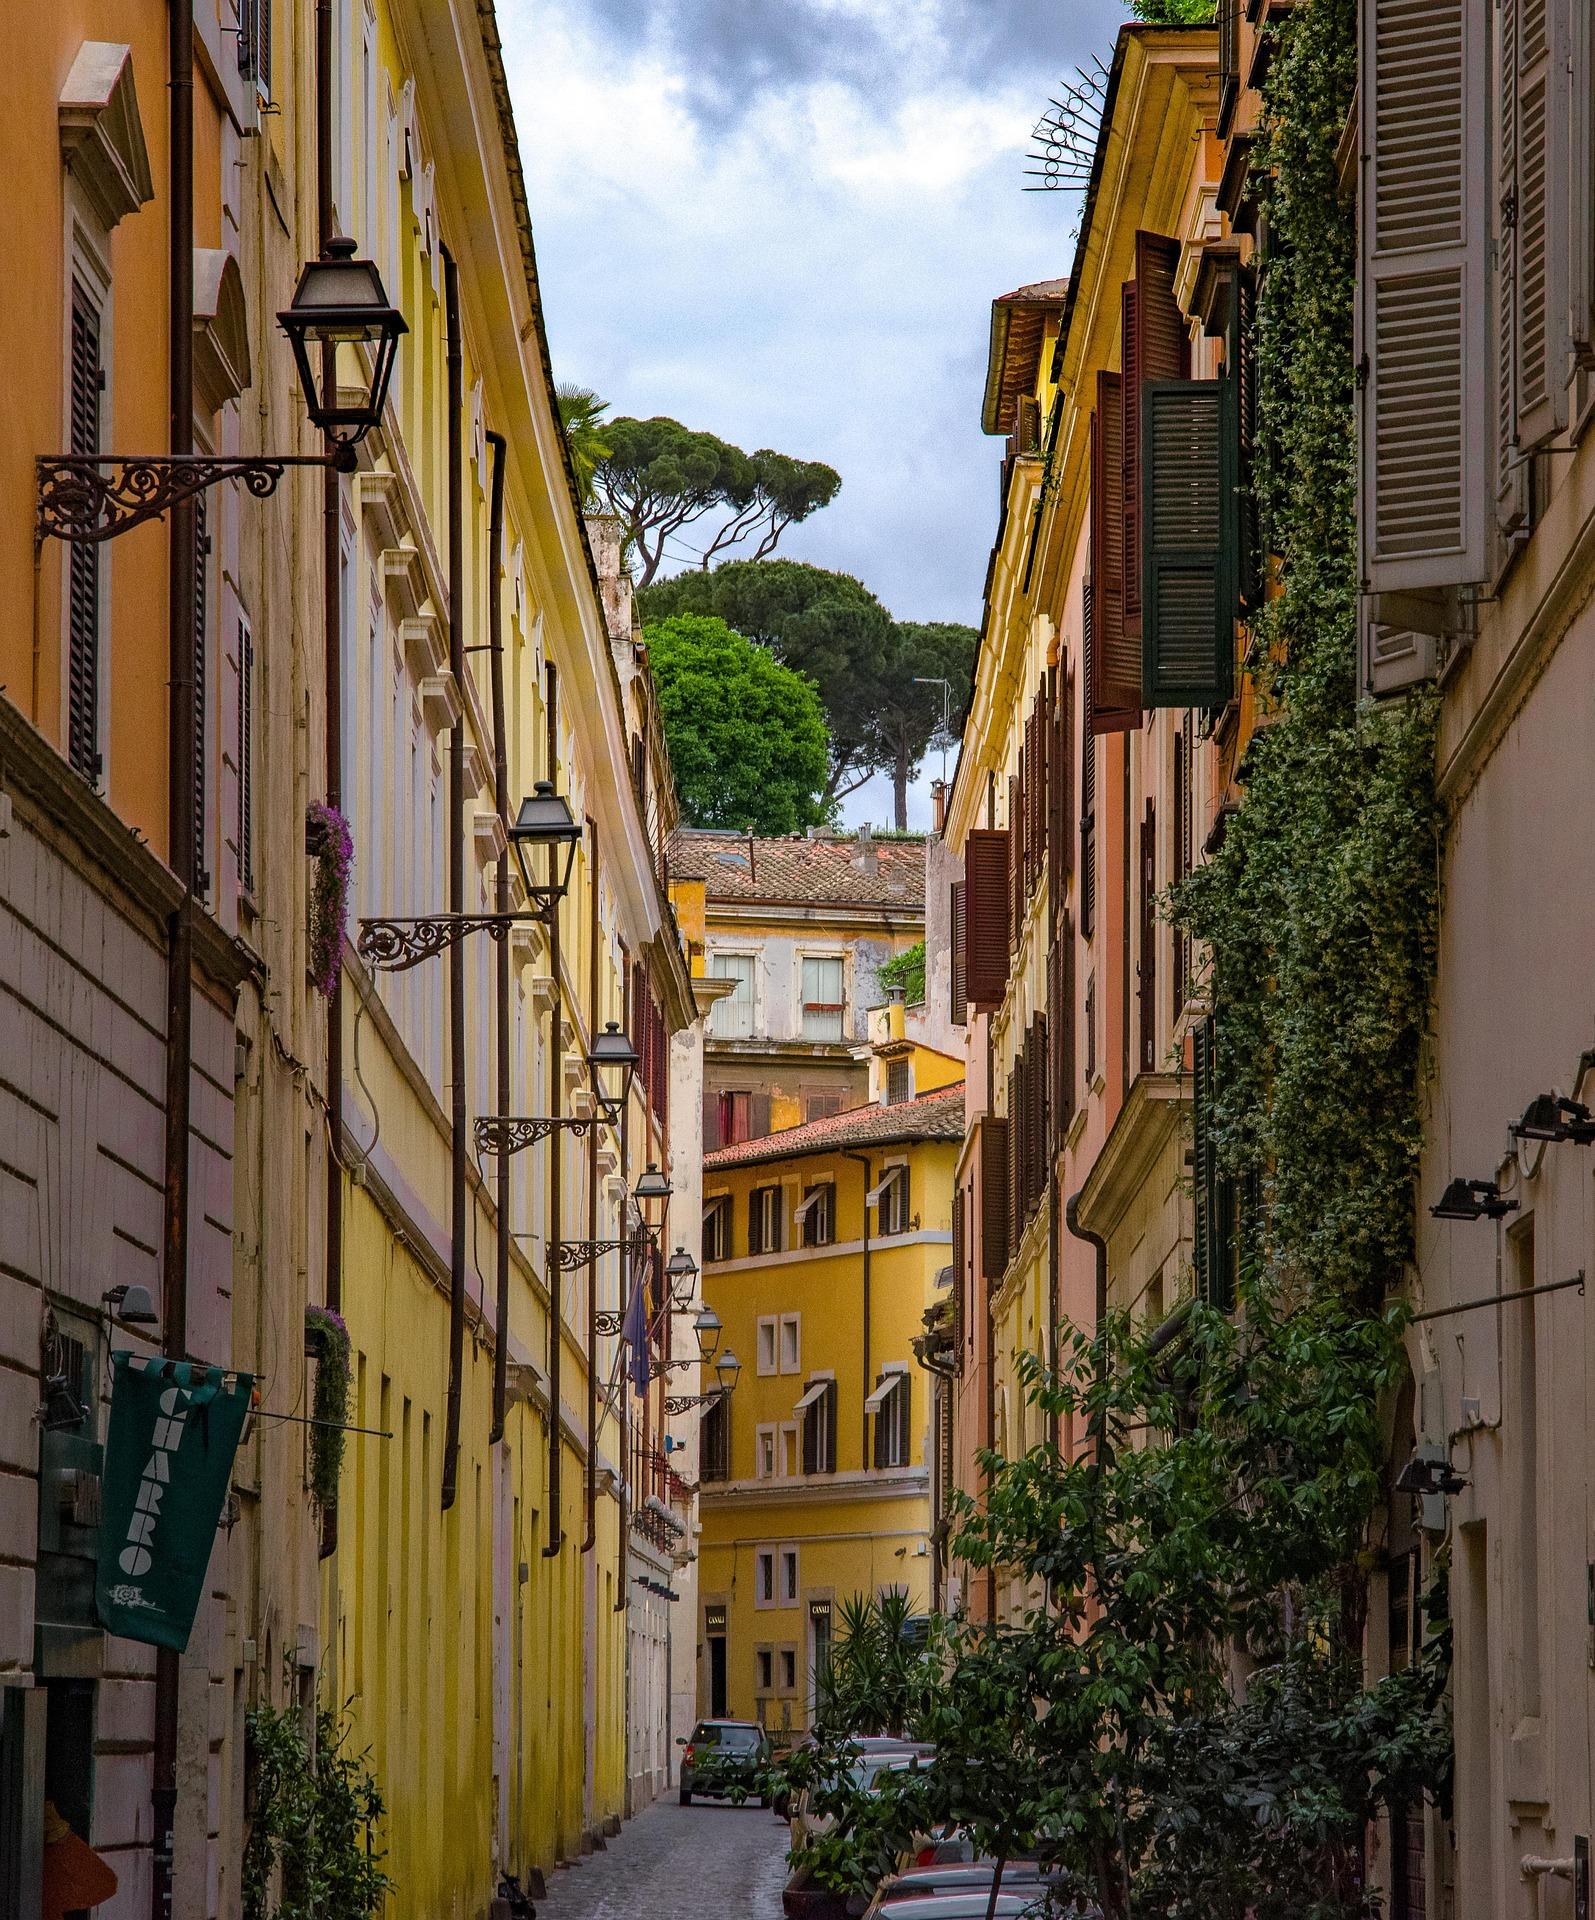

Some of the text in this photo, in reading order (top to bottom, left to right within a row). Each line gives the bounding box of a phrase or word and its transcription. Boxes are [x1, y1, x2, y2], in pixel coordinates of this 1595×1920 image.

[118, 1387, 192, 1576] CHARRO
[812, 1605, 829, 1614] CANALI
[708, 1616, 724, 1624] CANALI
